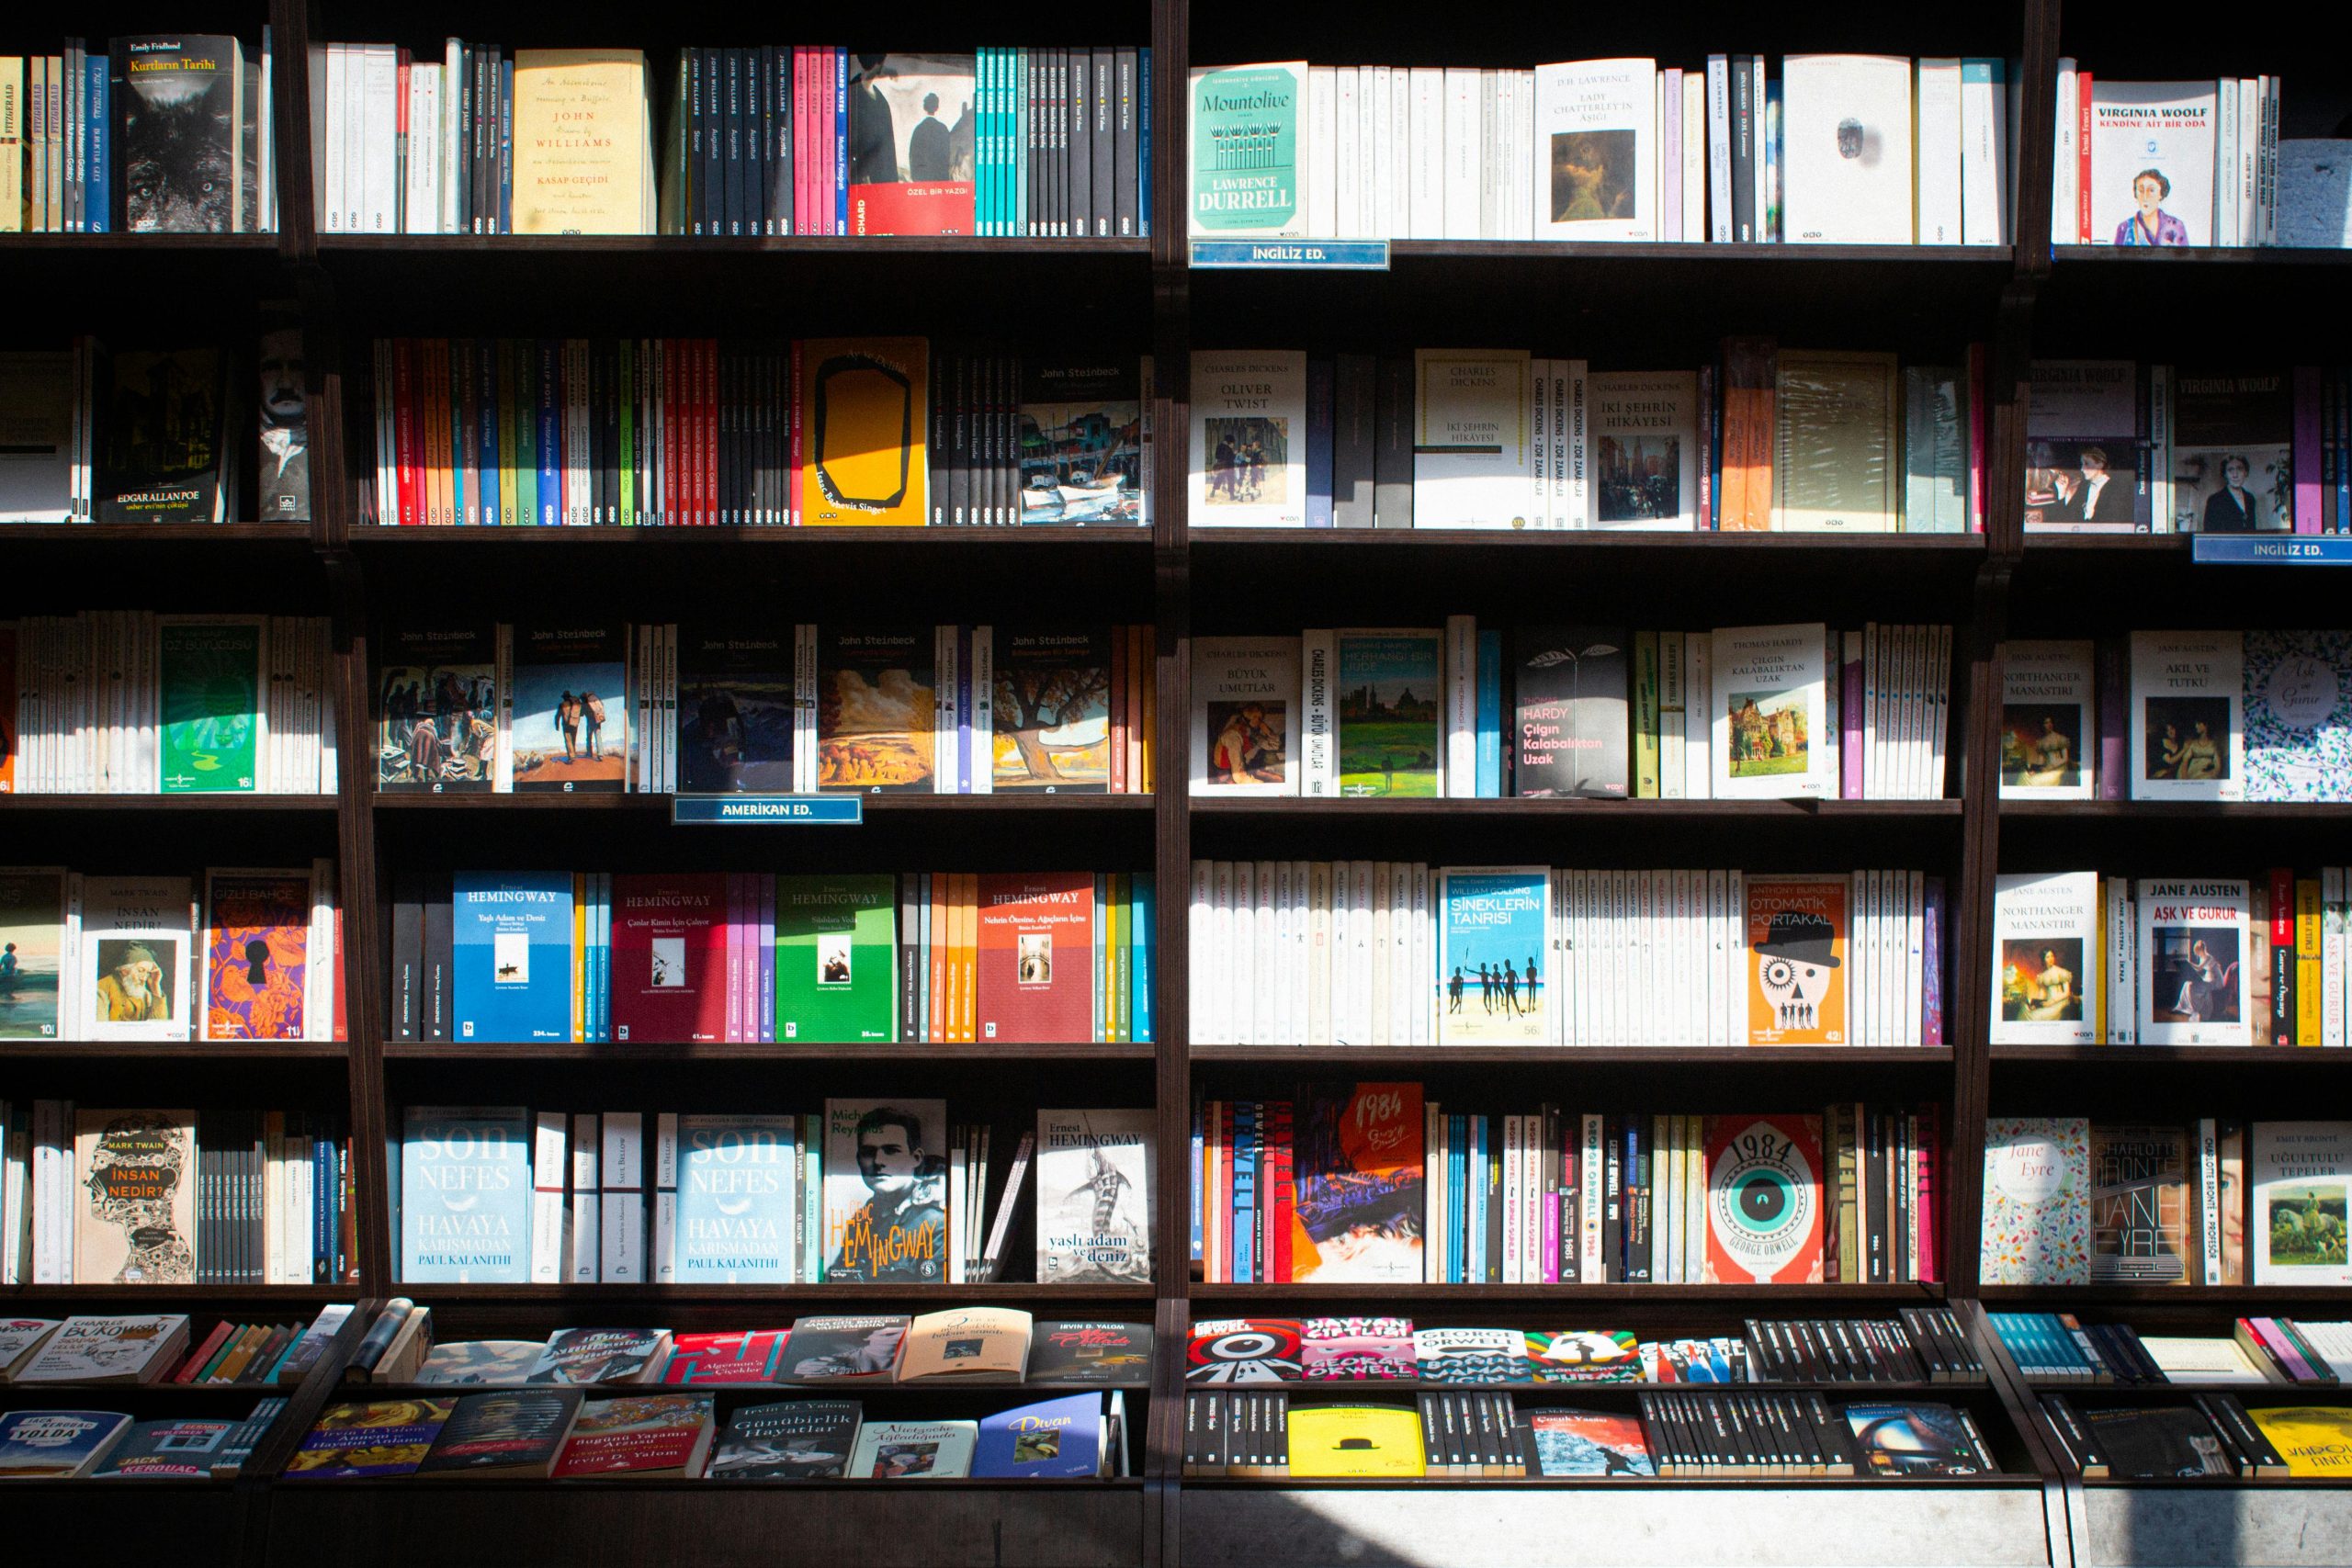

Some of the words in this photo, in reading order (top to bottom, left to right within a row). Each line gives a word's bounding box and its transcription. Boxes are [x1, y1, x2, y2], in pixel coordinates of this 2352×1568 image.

[130, 42, 150, 53] Emily
[151, 41, 181, 51] Fridlund
[130, 60, 179, 73] Kurtların
[181, 58, 217, 71] Tarihi
[838, 55, 846, 88] RICHARD
[1577, 74, 1631, 85] LAWRENCE
[462, 88, 470, 109] HENRY
[838, 91, 846, 113] YATES
[1202, 90, 1289, 112] Mountolive
[1580, 93, 1607, 102] LADY
[5, 84, 15, 134] FITZGERALD
[2098, 107, 2157, 118] VIRGINIA
[2161, 107, 2208, 118] WOOLF
[554, 111, 595, 121] JOHN
[2081, 107, 2090, 134] Feneri
[2098, 119, 2143, 128] KENDİNE
[2145, 119, 2162, 128] AİT
[2165, 119, 2182, 128] BİR
[2185, 119, 2206, 128] ODA
[536, 138, 613, 149] WILLIAMS
[779, 127, 788, 158] Augustus
[2081, 136, 2090, 155] Deniz
[537, 176, 570, 186] KASAP
[572, 175, 609, 186] GEÇİDİ
[836, 164, 845, 191] Fotoğrafı
[1212, 176, 1278, 191] LAWRENCE
[907, 186, 928, 196] ÖZEL
[930, 186, 944, 195] BİR
[944, 186, 969, 196] YAZGI
[1199, 189, 1293, 211] DURRELL
[1253, 245, 1303, 260] İNGİLİZ
[1306, 248, 1327, 260] ED.
[1040, 369, 1066, 379] John
[1068, 367, 1121, 378] Steinbeck
[1451, 378, 1497, 388] DICKENS
[2179, 378, 2235, 394] VIRGINIA
[2238, 378, 2280, 393] WOOLF
[1221, 384, 1272, 396] OLIVER
[1534, 378, 1544, 406] CHARLES
[1224, 398, 1269, 410] TWIST
[1601, 402, 1620, 413] İKİ
[1625, 400, 1677, 415] ŞEHRİN
[1534, 407, 1544, 436] DICKENS
[1534, 444, 1544, 458] ZOR
[814, 469, 829, 495] Isaac
[118, 492, 148, 502] EDGAR
[149, 491, 180, 502] ALLAN
[181, 491, 199, 501] POE
[2254, 541, 2301, 556] İNGİLİZ
[2304, 545, 2324, 556] ED.
[838, 637, 861, 646] John
[865, 636, 916, 646] Steinbeck
[1751, 655, 1785, 667] ÇILGIN
[1227, 665, 1268, 680] BÜYÜK
[1732, 663, 1805, 675] KALABALIKTAN
[1756, 673, 1781, 683] UZAK
[1219, 682, 1275, 693] UMUTLAR
[1523, 696, 1559, 705] THOMAS
[1523, 707, 1568, 720] HARDY
[1523, 724, 1560, 738] Çılgın
[1523, 737, 1603, 750] Kalabalıktan
[1523, 752, 1555, 765] Uzak
[722, 801, 790, 816] AMERİKAN
[793, 805, 813, 816] ED.
[468, 891, 557, 903] HEMINGWAY
[1451, 887, 1488, 897] WILLIAM
[1490, 886, 1531, 896] GOLDING
[2150, 884, 2186, 897] JANE
[2189, 884, 2240, 897] AUSTEN
[992, 892, 1080, 905] HEMINGWAY
[1451, 897, 1540, 912] SİNEKLERİN
[1749, 895, 1827, 910] OTOMATİK
[118, 907, 159, 918] İNSAN
[2002, 905, 2084, 917] NORTHANGER
[2154, 906, 2177, 923] AŞK
[2181, 906, 2194, 919] VE
[2197, 906, 2237, 920] GURUR
[114, 919, 163, 931] NEDİR?
[478, 914, 495, 924] Yaşlı
[496, 913, 515, 921] Adam
[526, 913, 547, 922] Deniz
[628, 919, 650, 928] Çanlar
[650, 918, 671, 927] Kimin
[672, 917, 685, 928] İçin
[686, 917, 709, 928] Çalıyor
[984, 916, 1009, 924] Nehrin
[1037, 916, 1069, 926] Ağaçların
[1069, 913, 1087, 924] İçine
[1451, 912, 1512, 925] TANRISI
[1750, 913, 1833, 926] PORTAKAL
[2010, 919, 2075, 931] MANASTIRI
[1354, 1090, 1402, 1129] 1984
[1049, 1122, 1080, 1133] Ernest
[135, 1141, 164, 1149] TWAIN
[1049, 1133, 1141, 1147] HEMINGWAY
[1588, 1120, 1598, 1168] GEORGE
[1729, 1134, 1793, 1164] 1984
[2009, 1143, 2044, 1159] Jane
[2270, 1151, 2345, 1164] UĞULTULU
[111, 1168, 160, 1181] İNSAN
[2021, 1160, 2055, 1181] Eyre
[2279, 1165, 2336, 1177] TEPELER
[419, 1166, 511, 1191] NEFES
[108, 1183, 163, 1198] NEDİR?
[1588, 1171, 1598, 1218] ORWELL
[850, 1199, 874, 1223] GENÇ
[418, 1214, 512, 1235] HAVAYA
[831, 1208, 938, 1278] HEMINGWAY
[1049, 1233, 1083, 1250] yaşlı
[1087, 1233, 1127, 1247] adam
[1728, 1235, 1761, 1256] GEORGE
[1763, 1235, 1799, 1257] ORWELL
[1072, 1247, 1086, 1257] ve
[1088, 1248, 1127, 1263] deniz
[1565, 1237, 1574, 1261] 1984
[418, 1255, 447, 1265] PAUL
[449, 1254, 512, 1265] KALANITHI
[1306, 1318, 1407, 1329] HAYVAN
[1421, 1330, 1516, 1340] GEORGE
[1423, 1337, 1518, 1348] ORWELL
[1311, 1357, 1408, 1368] GEORGE
[1306, 1365, 1407, 1377] ORWELL
[735, 1416, 851, 1432] Günübirlik
[17, 1429, 77, 1439] YOLDA
[744, 1424, 837, 1438] Hayatlar
[122, 1465, 197, 1474] KEROUAC
